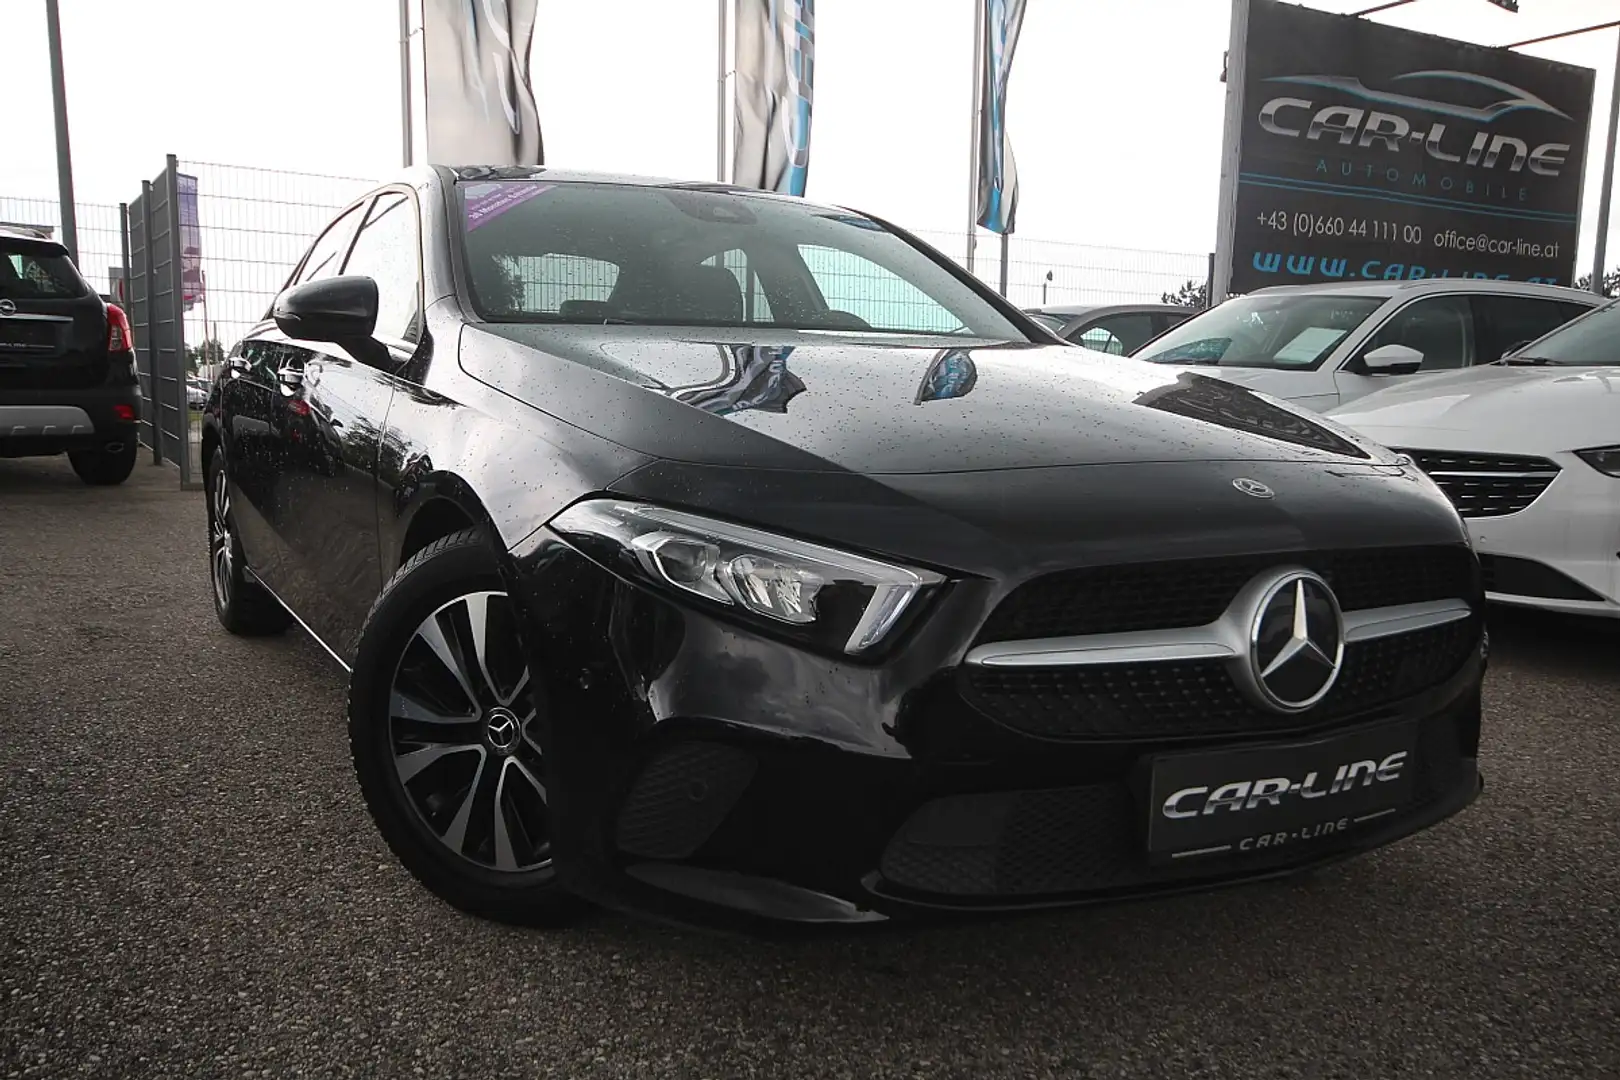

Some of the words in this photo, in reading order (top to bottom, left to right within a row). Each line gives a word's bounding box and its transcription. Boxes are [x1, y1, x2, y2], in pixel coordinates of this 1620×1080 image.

[1258, 97, 1571, 177] CAR-LINE
[1316, 159, 1528, 201] AUTOMOBILE
[1257, 211, 1288, 231] +43
[1293, 212, 1345, 238] (0)660
[1348, 219, 1367, 237] 44
[1373, 220, 1398, 241] 111
[1403, 225, 1422, 245] 00
[1433, 229, 1560, 259] office@car-line.at
[1162, 751, 1408, 819] CAR-LINE
